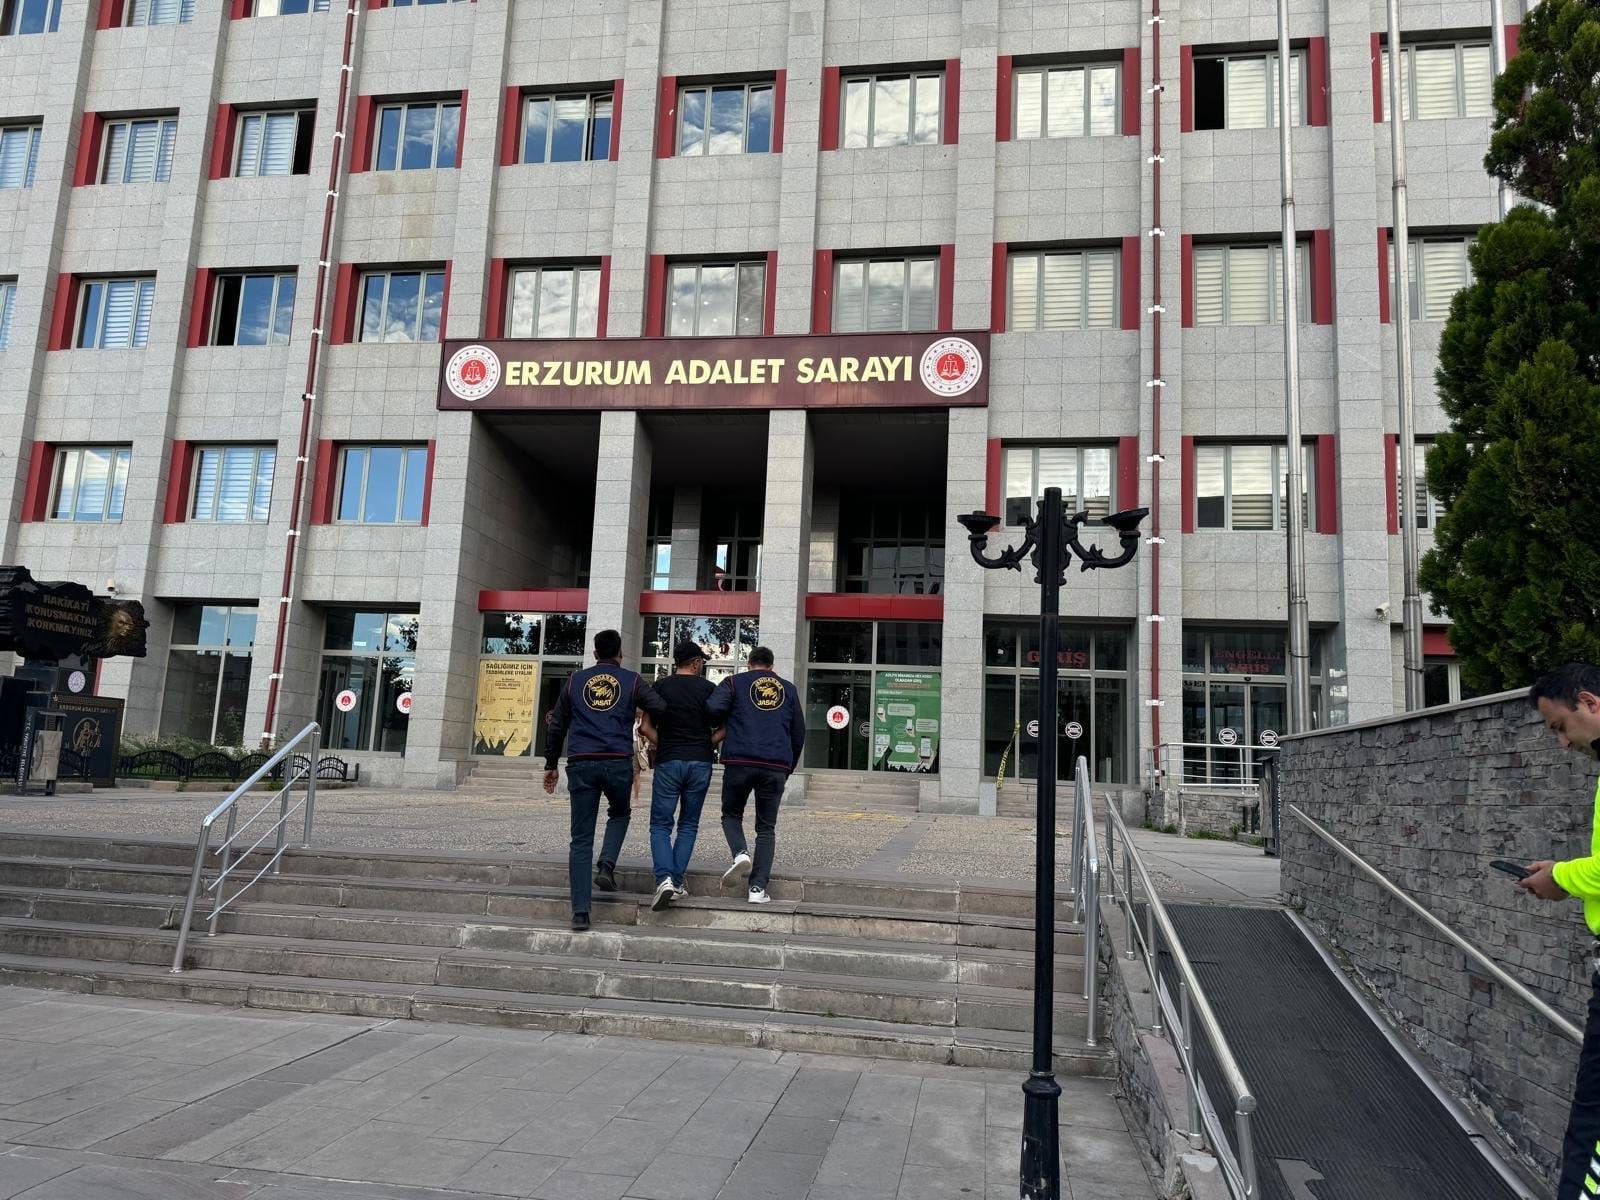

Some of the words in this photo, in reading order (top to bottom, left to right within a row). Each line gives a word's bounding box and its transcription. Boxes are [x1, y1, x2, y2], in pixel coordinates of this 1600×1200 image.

[505, 360, 652, 386] ERZURUM
[665, 358, 785, 385] ADALET
[796, 355, 913, 384] SARAYI
[587, 673, 618, 688] JANDARMA
[754, 676, 783, 690] JANDARMA
